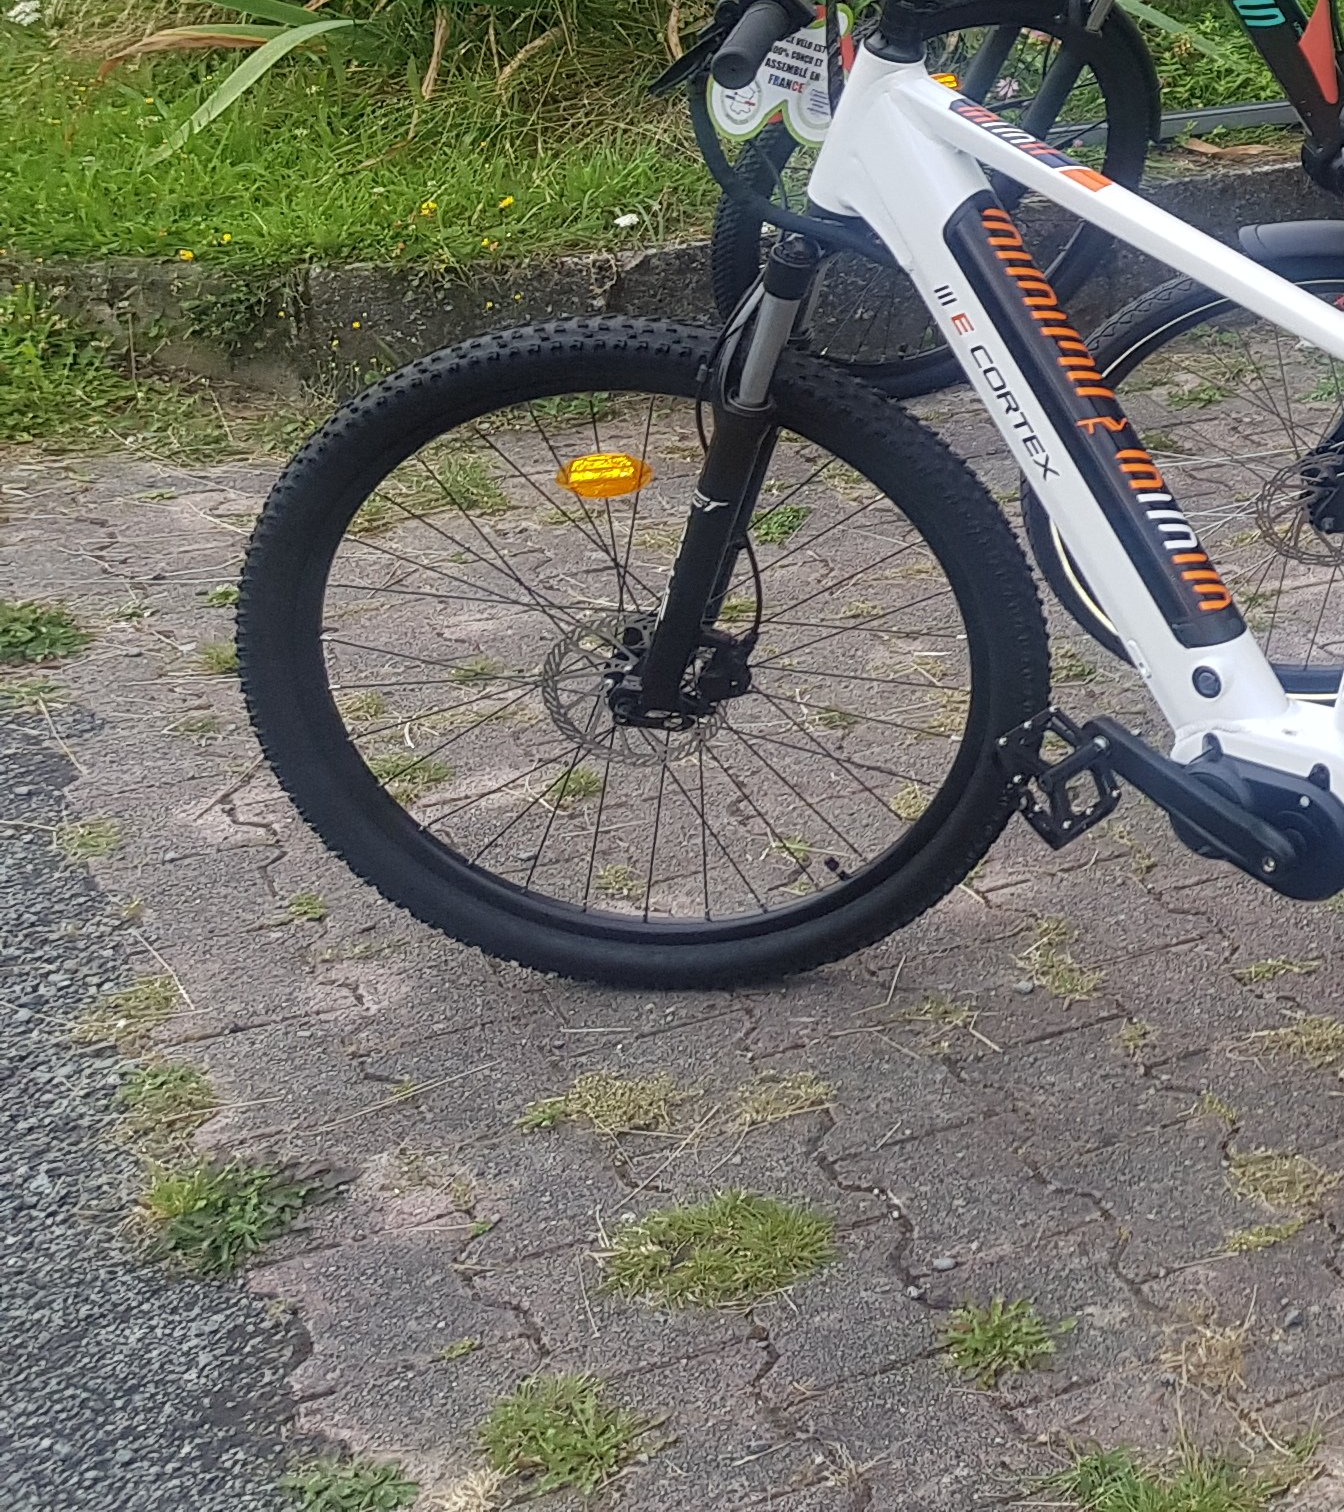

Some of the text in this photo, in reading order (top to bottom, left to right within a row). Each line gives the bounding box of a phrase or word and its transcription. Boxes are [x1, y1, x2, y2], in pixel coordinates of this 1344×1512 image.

[768, 73, 806, 93] FRANCE
[950, 311, 975, 337] E
[969, 344, 1061, 481] CORTEX
